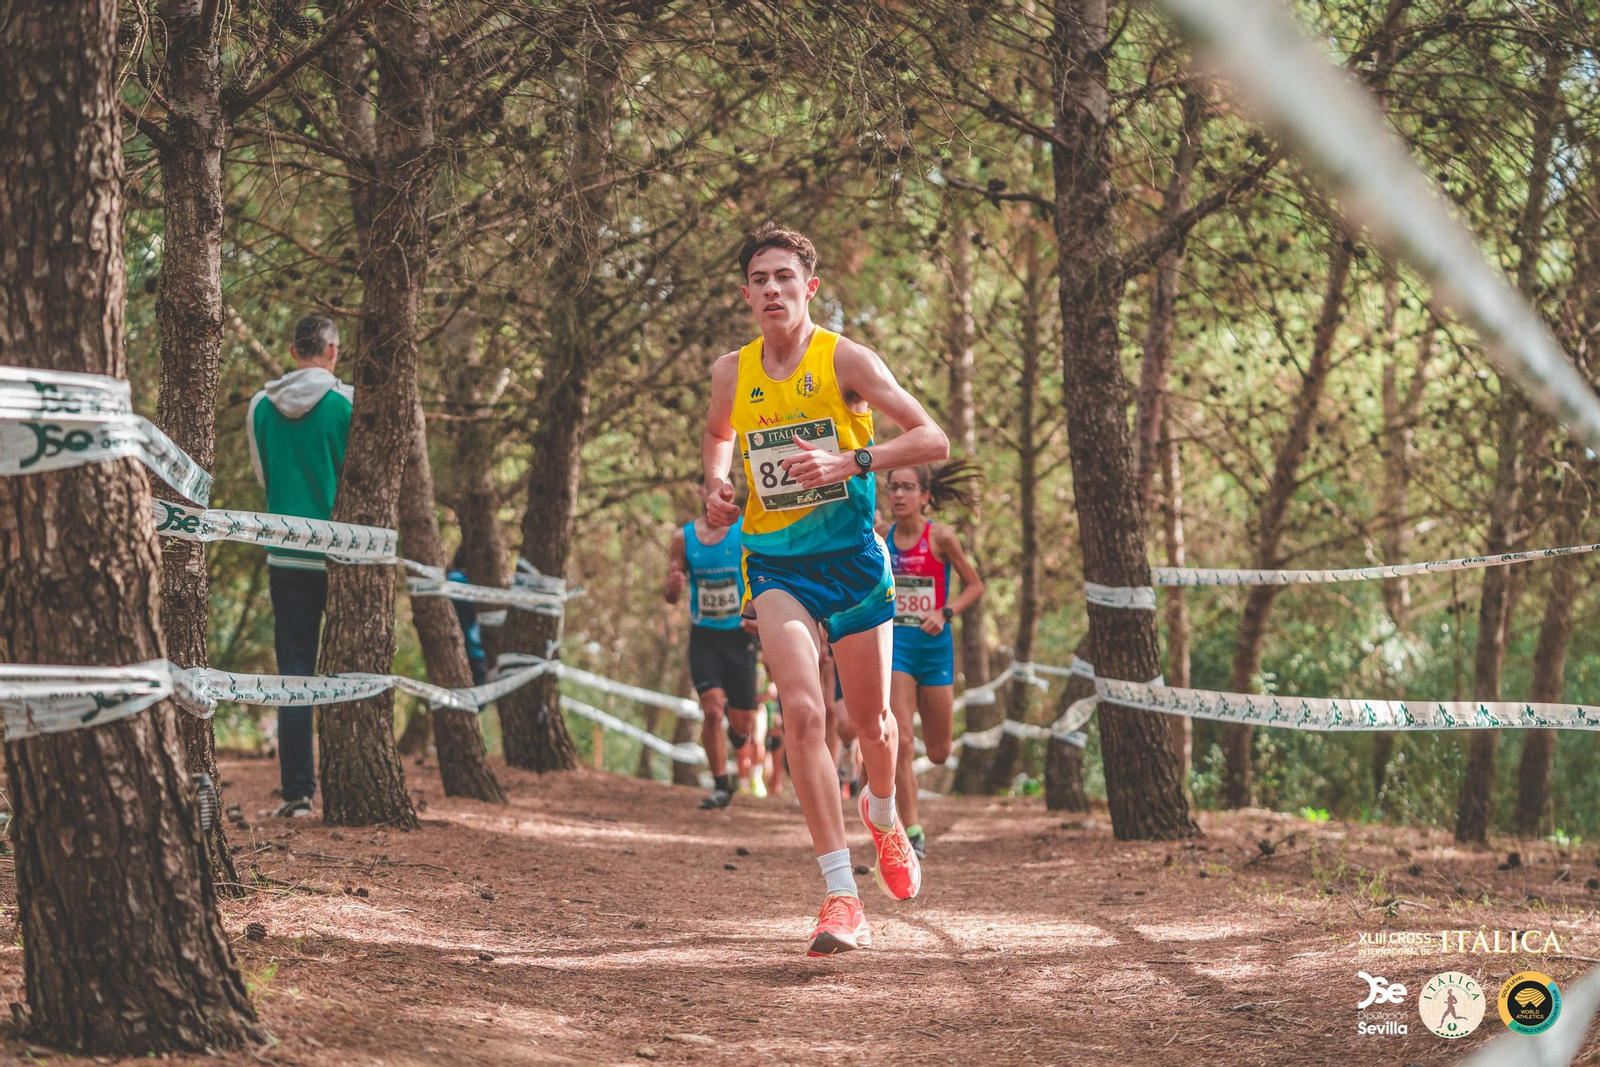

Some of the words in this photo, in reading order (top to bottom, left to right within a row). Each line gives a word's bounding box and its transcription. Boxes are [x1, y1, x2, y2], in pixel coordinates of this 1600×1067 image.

[768, 427, 811, 442] ITÁLICA
[759, 459, 797, 489] 82
[897, 595, 931, 612] 580
